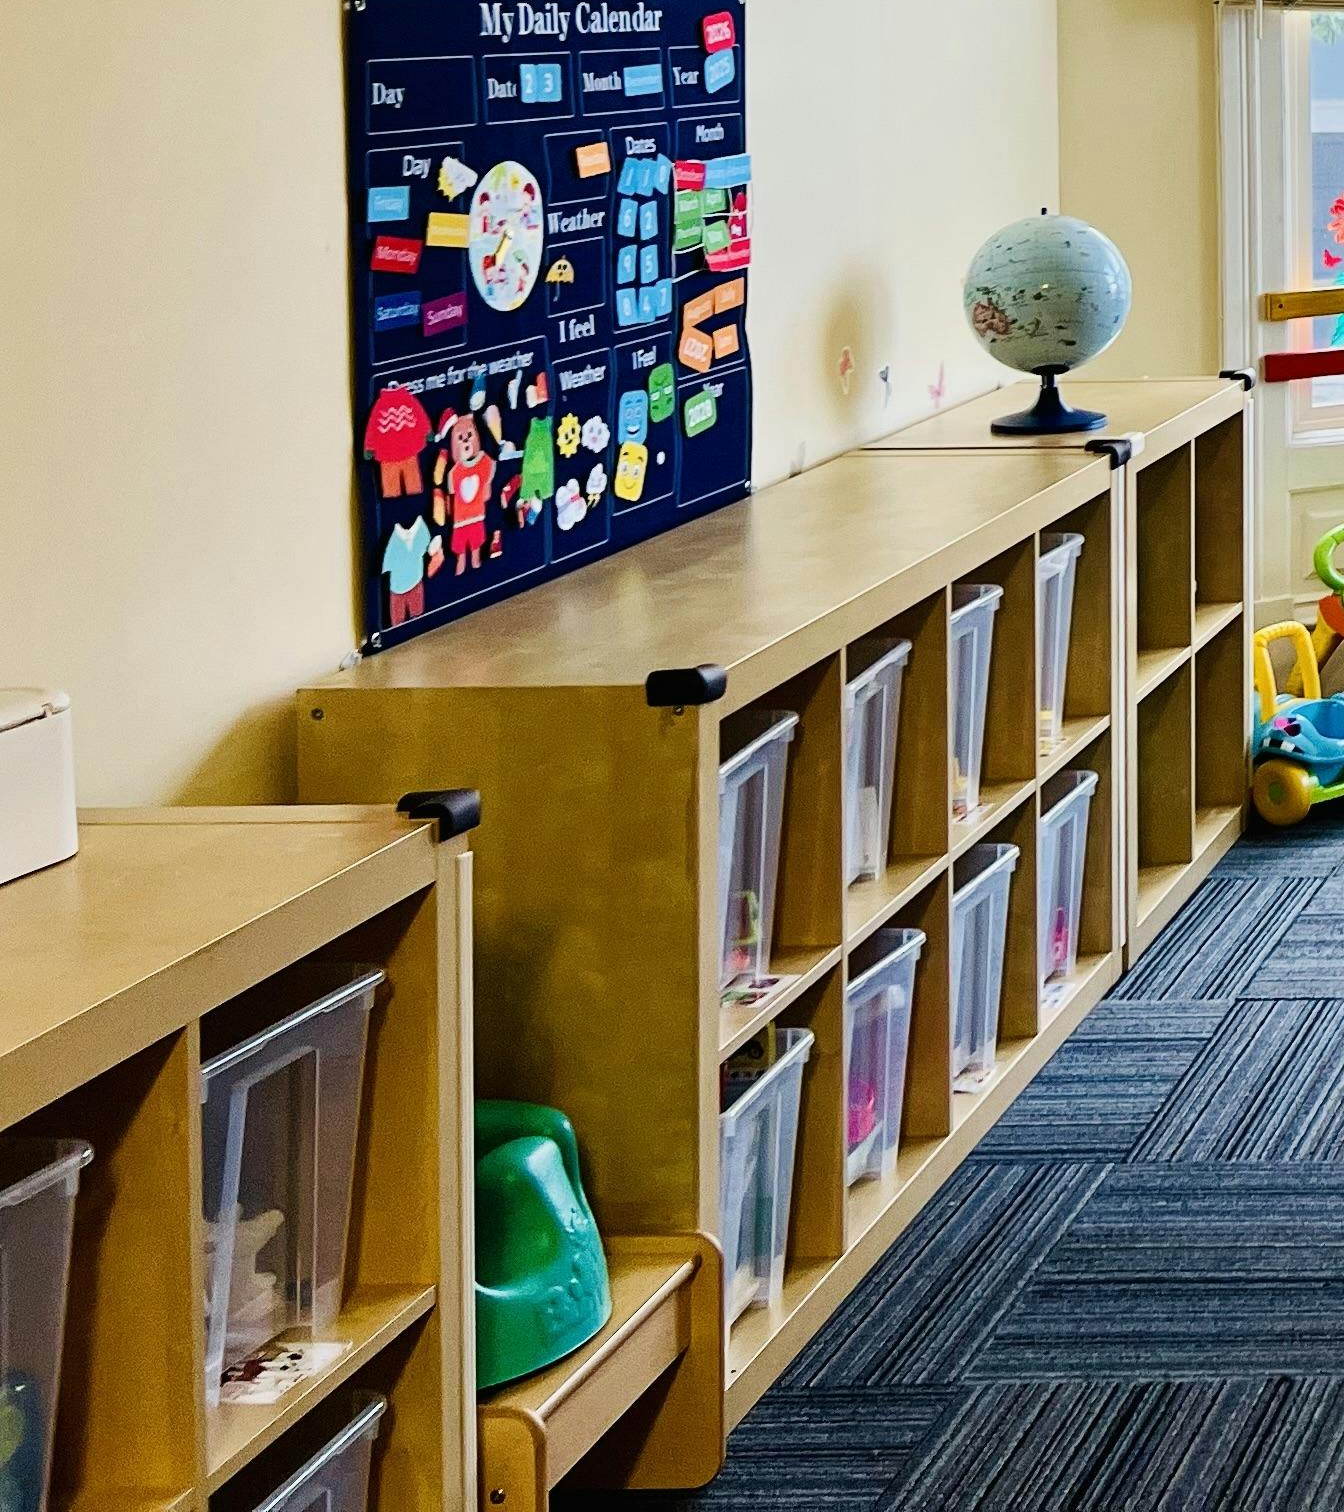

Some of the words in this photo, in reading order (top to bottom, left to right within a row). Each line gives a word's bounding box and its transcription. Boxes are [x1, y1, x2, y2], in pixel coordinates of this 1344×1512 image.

[479, 3, 514, 43] My
[517, 2, 570, 42] Daily
[575, 1, 663, 35] Calendar
[582, 71, 622, 92] Month
[672, 66, 700, 86] Year
[371, 83, 405, 108] Day
[625, 136, 656, 155] Dates
[402, 155, 431, 179] Day
[547, 208, 605, 235] Weather
[376, 245, 418, 266] Monday
[559, 321, 566, 342] I
[568, 313, 595, 340] feel
[387, 378, 425, 395] Dess
[447, 365, 468, 385] for
[559, 363, 606, 392] Weather
